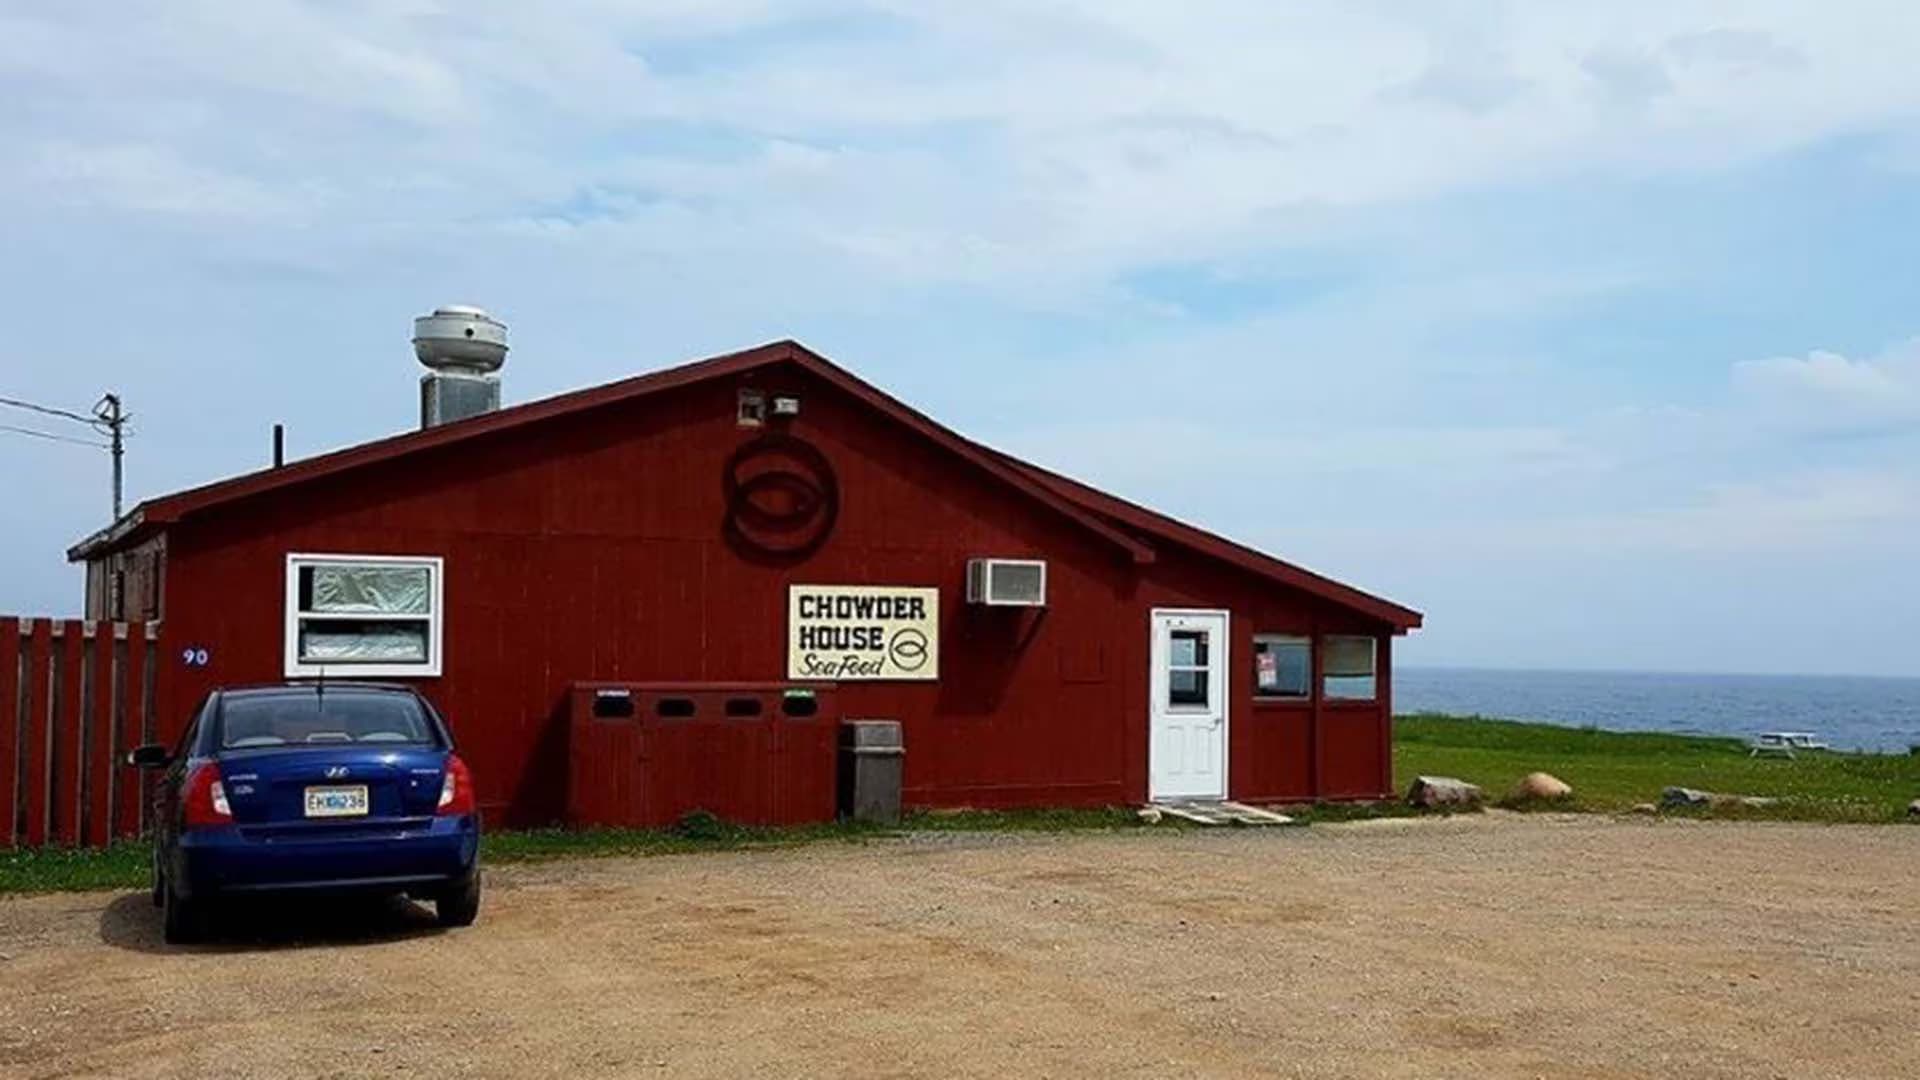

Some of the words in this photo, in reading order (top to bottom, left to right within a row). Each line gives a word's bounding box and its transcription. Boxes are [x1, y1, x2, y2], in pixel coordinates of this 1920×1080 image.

[799, 595, 926, 619] CHOWDER
[799, 626, 884, 650] HOUSE
[183, 649, 208, 665] 90
